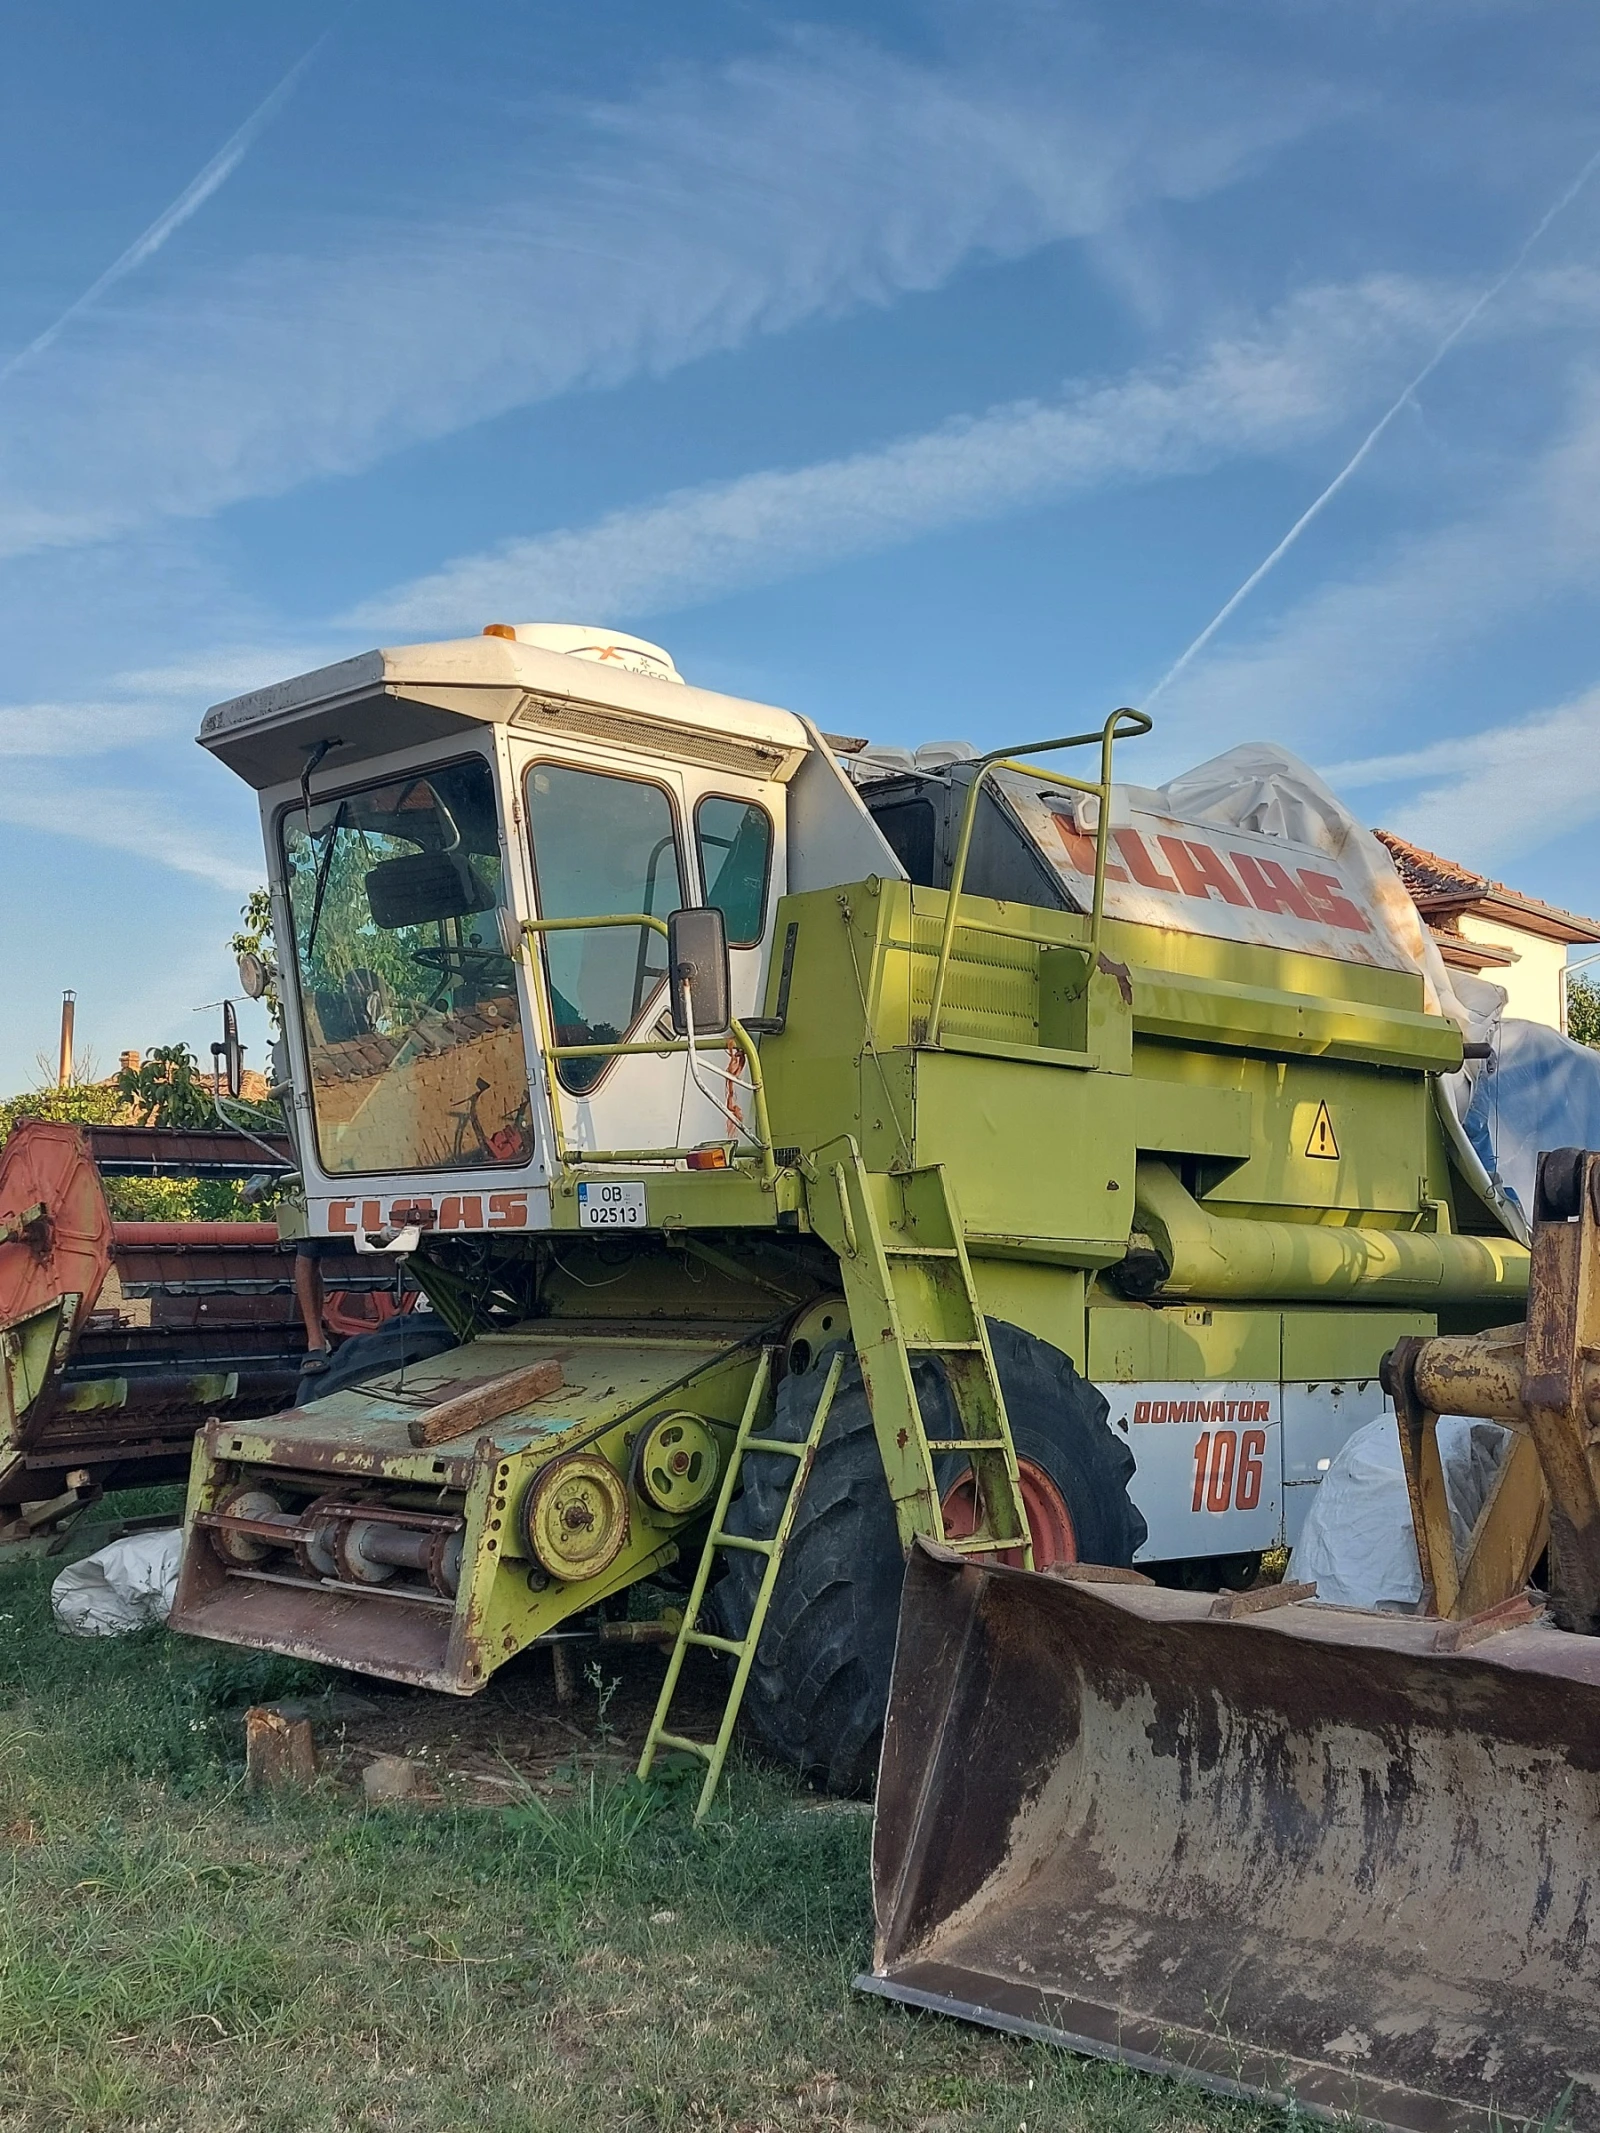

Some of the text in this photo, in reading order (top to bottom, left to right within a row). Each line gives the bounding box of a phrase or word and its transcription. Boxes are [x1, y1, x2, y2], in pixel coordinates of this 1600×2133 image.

[1051, 812, 1370, 933] CLAAS
[602, 1187, 622, 1202] OB
[590, 1207, 637, 1223] 02513
[1134, 1401, 1270, 1424] DOMINATOR
[1191, 1430, 1266, 1513] 106
